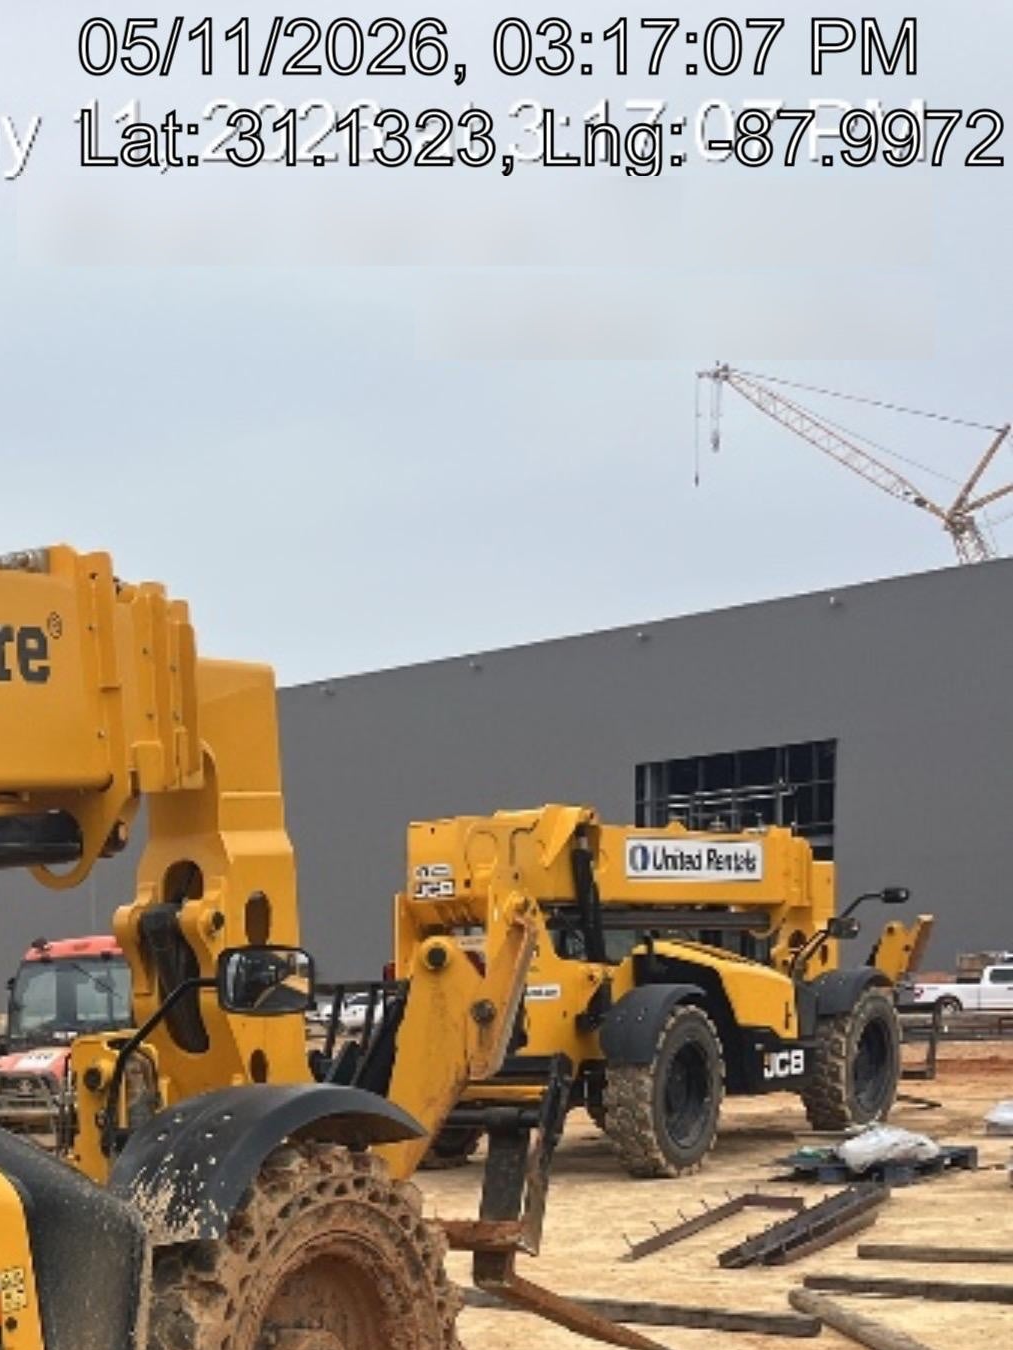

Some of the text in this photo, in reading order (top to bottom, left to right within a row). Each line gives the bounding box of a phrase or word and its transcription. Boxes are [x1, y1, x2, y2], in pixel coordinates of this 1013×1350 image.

[652, 844, 757, 873] United Rentals
[763, 1049, 805, 1079] JCB
